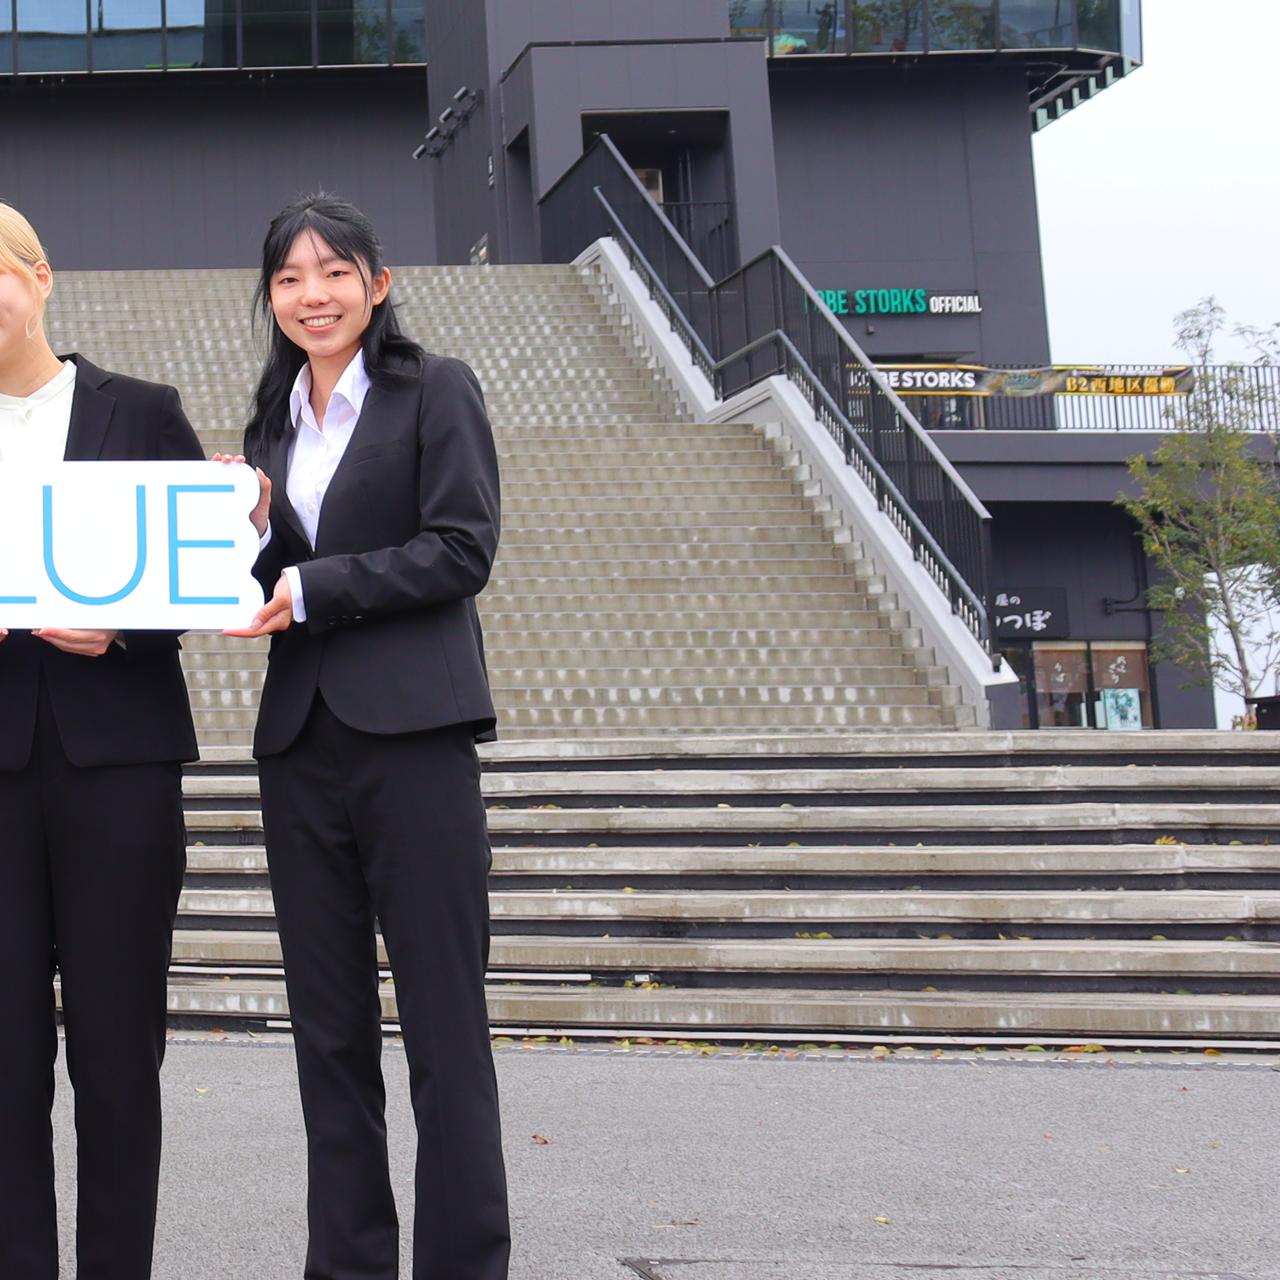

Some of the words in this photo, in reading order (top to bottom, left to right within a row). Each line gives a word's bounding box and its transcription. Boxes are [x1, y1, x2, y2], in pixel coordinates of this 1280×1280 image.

[854, 288, 928, 314] STORKS
[928, 295, 982, 313] OFFICIAL
[901, 371, 976, 388] STORKS
